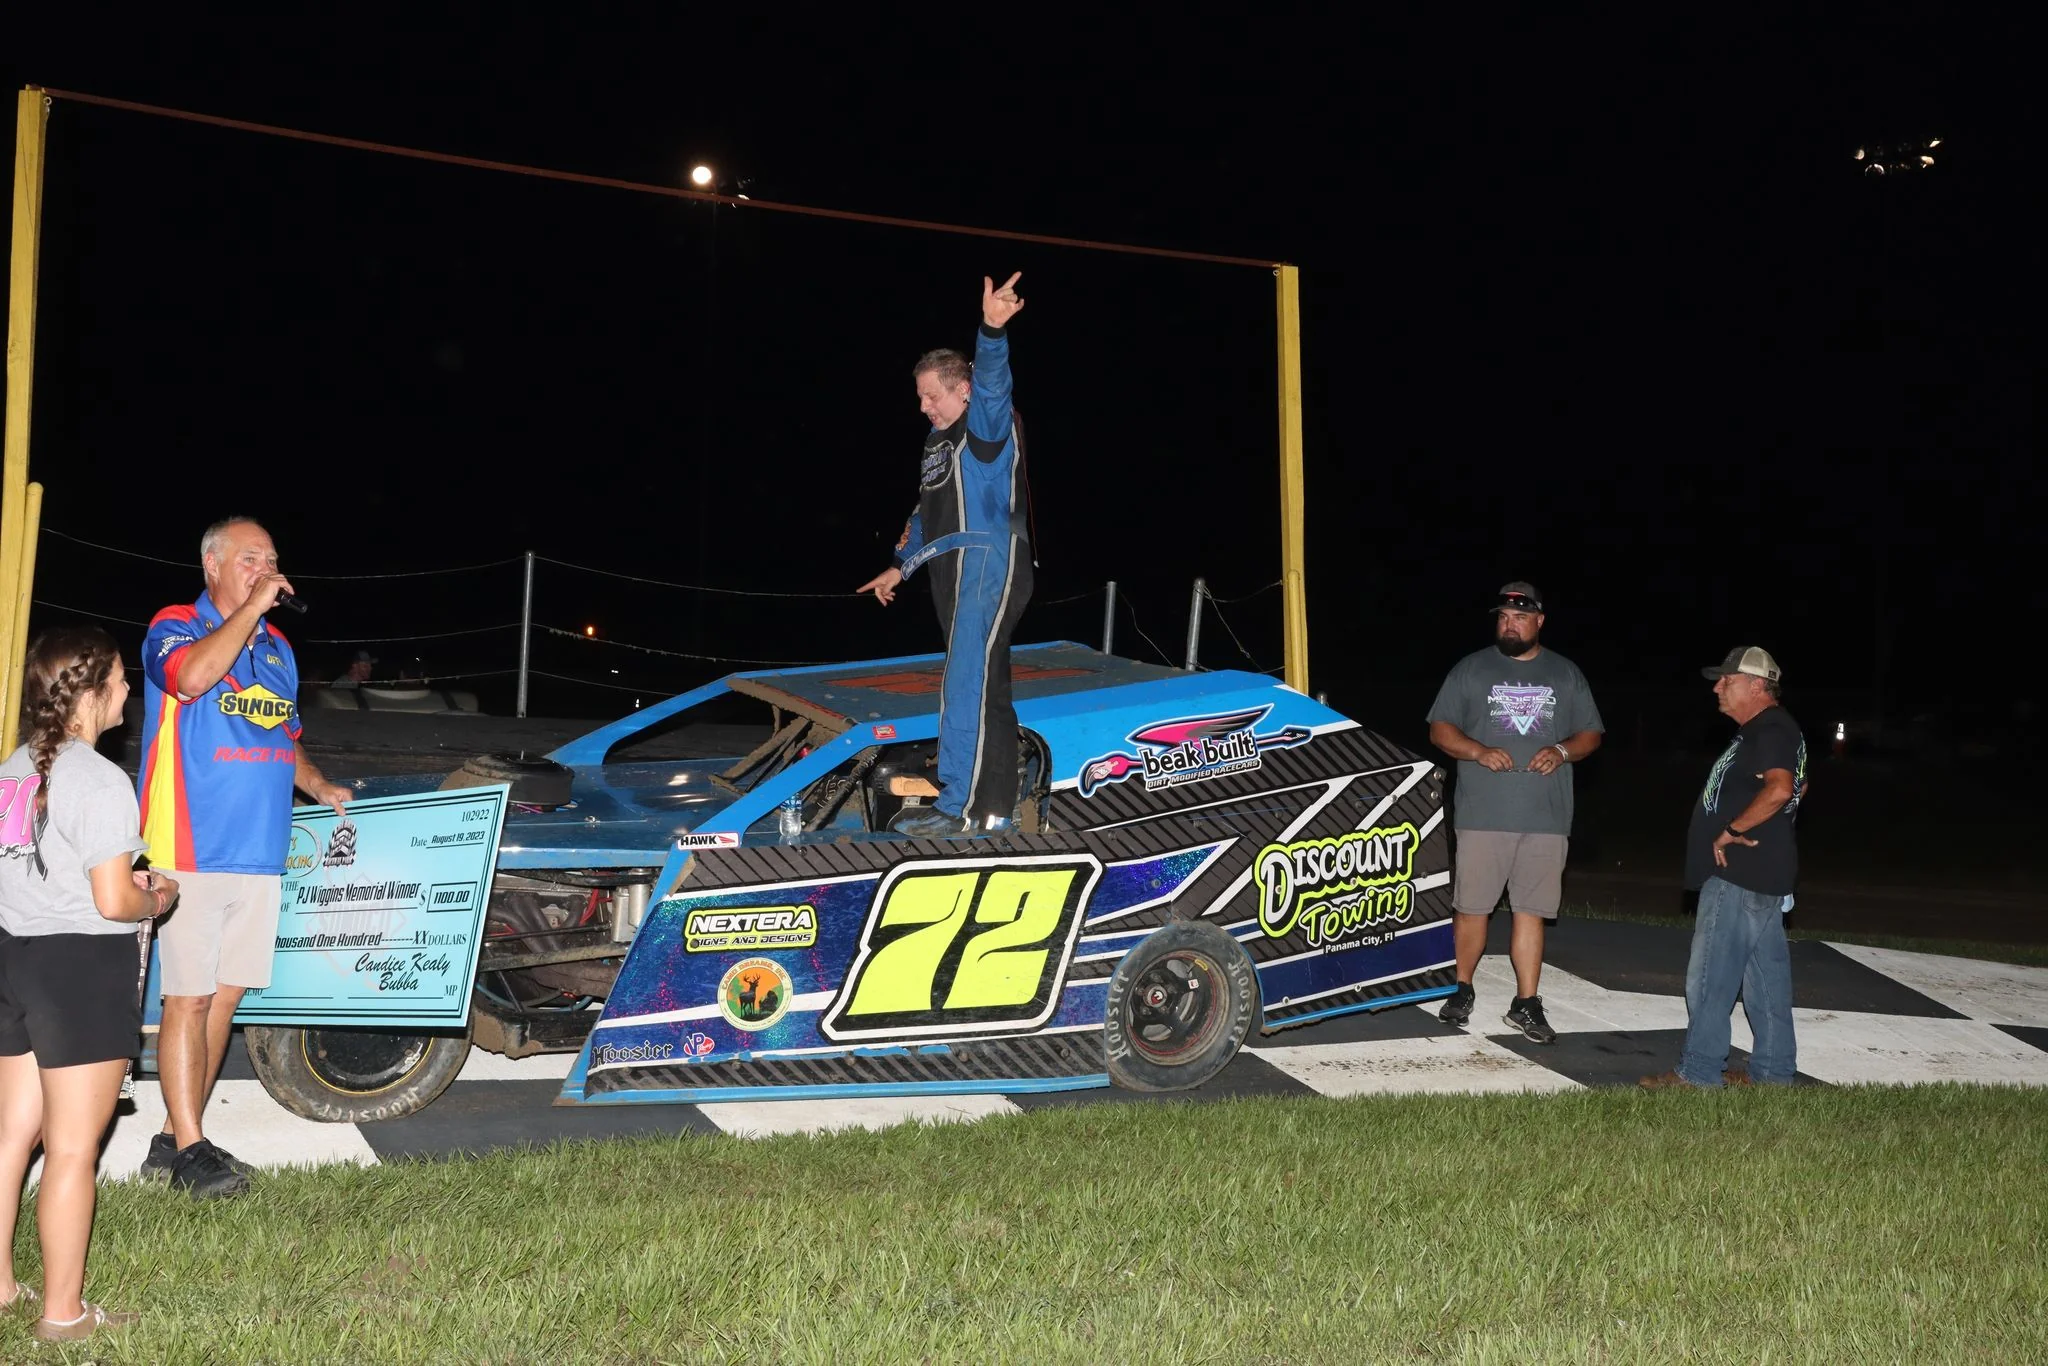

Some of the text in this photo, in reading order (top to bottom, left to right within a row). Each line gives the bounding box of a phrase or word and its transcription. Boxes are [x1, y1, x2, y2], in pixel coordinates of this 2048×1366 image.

[224, 695, 294, 719] SUNOCO
[213, 746, 296, 764] RACE FU
[1142, 730, 1255, 776] beak built
[1148, 759, 1259, 788] DIRT MODIFIED RACECARS
[462, 809, 490, 822] 102922
[411, 836, 427, 847] Date
[431, 834, 456, 845] August
[466, 830, 485, 840] 2023
[680, 835, 717, 846] HAWK
[284, 855, 313, 869] ACING
[285, 881, 299, 892] THE
[296, 886, 311, 904] PJ
[310, 885, 344, 907] Wiggins
[345, 881, 387, 901] Memorial
[387, 881, 421, 900] Winner
[434, 890, 470, 904] 1100.00
[690, 911, 812, 933] NEXTERA
[1301, 886, 1409, 941] Towing
[275, 934, 317, 949] housand
[316, 933, 337, 948] One
[428, 934, 467, 945] DOLLARS
[696, 934, 811, 946] IGNS AND DESIGNS
[847, 869, 1077, 1016] 72
[1325, 940, 1360, 953] Panama
[1361, 936, 1383, 946] City,
[355, 952, 451, 977] Candice Kealy
[378, 971, 419, 991] Bubba
[444, 985, 458, 996] MP
[592, 1040, 673, 1068] Hoosier
